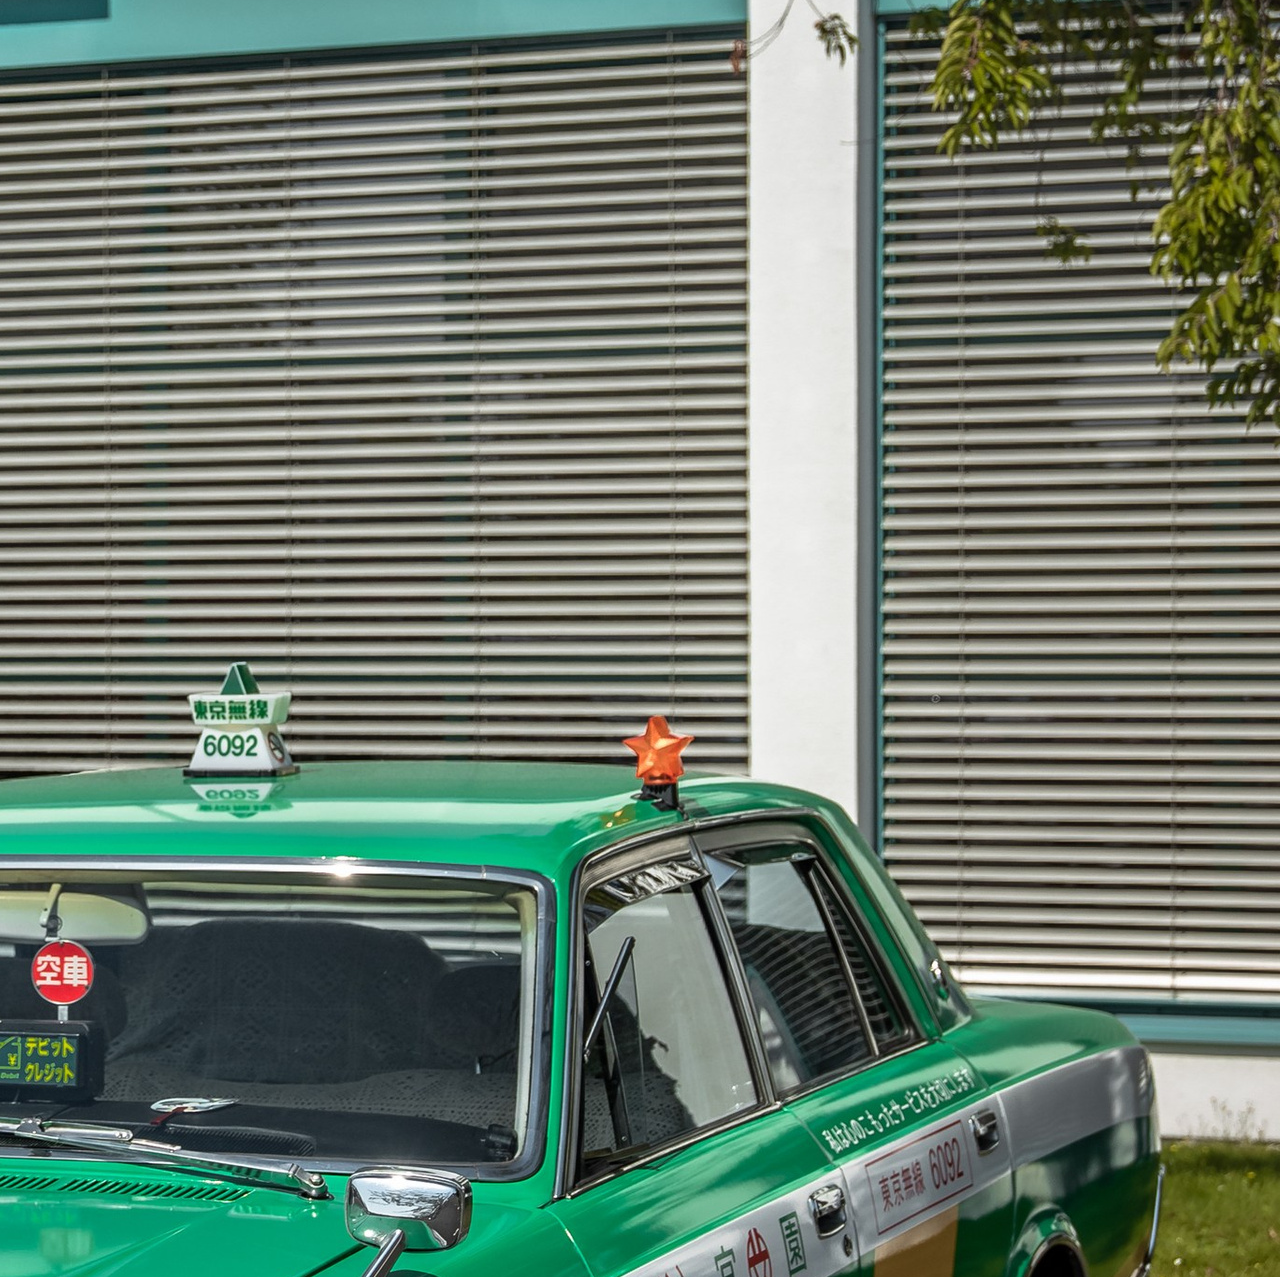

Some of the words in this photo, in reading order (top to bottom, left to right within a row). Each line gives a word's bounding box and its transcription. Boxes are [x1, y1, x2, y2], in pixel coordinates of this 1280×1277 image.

[194, 699, 269, 720] 東京無線
[203, 734, 258, 757] 6092
[36, 954, 89, 987] 空車
[25, 1036, 75, 1058] デビット
[25, 1062, 75, 1083] クレジット
[878, 1158, 926, 1212] 東京無線
[928, 1137, 964, 1189] 6092
